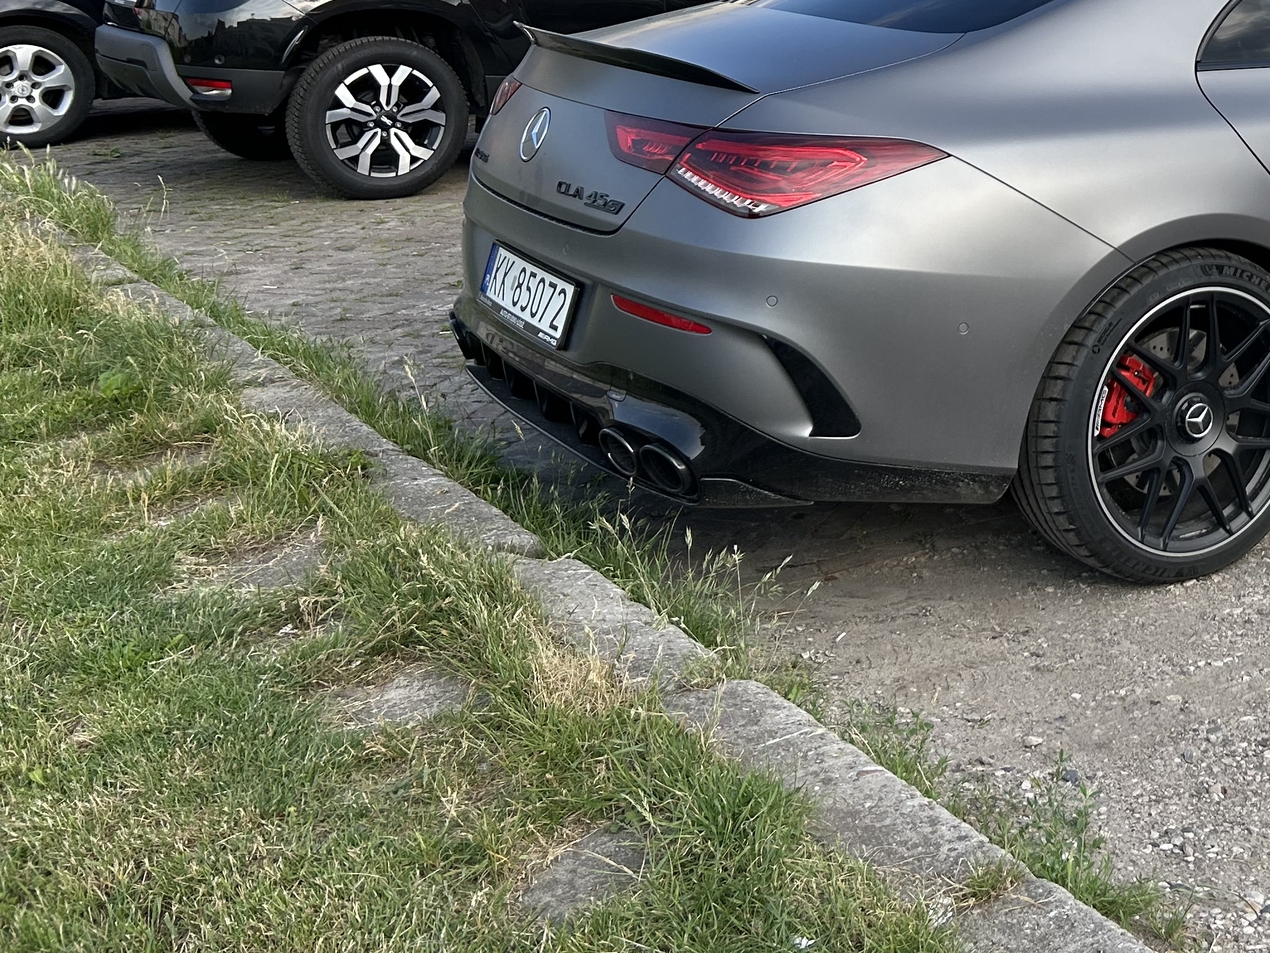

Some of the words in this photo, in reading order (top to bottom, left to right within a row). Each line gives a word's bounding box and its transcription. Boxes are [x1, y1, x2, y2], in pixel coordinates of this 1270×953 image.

[556, 180, 585, 200] CLA
[489, 253, 516, 301] KK
[511, 266, 567, 332] 85072
